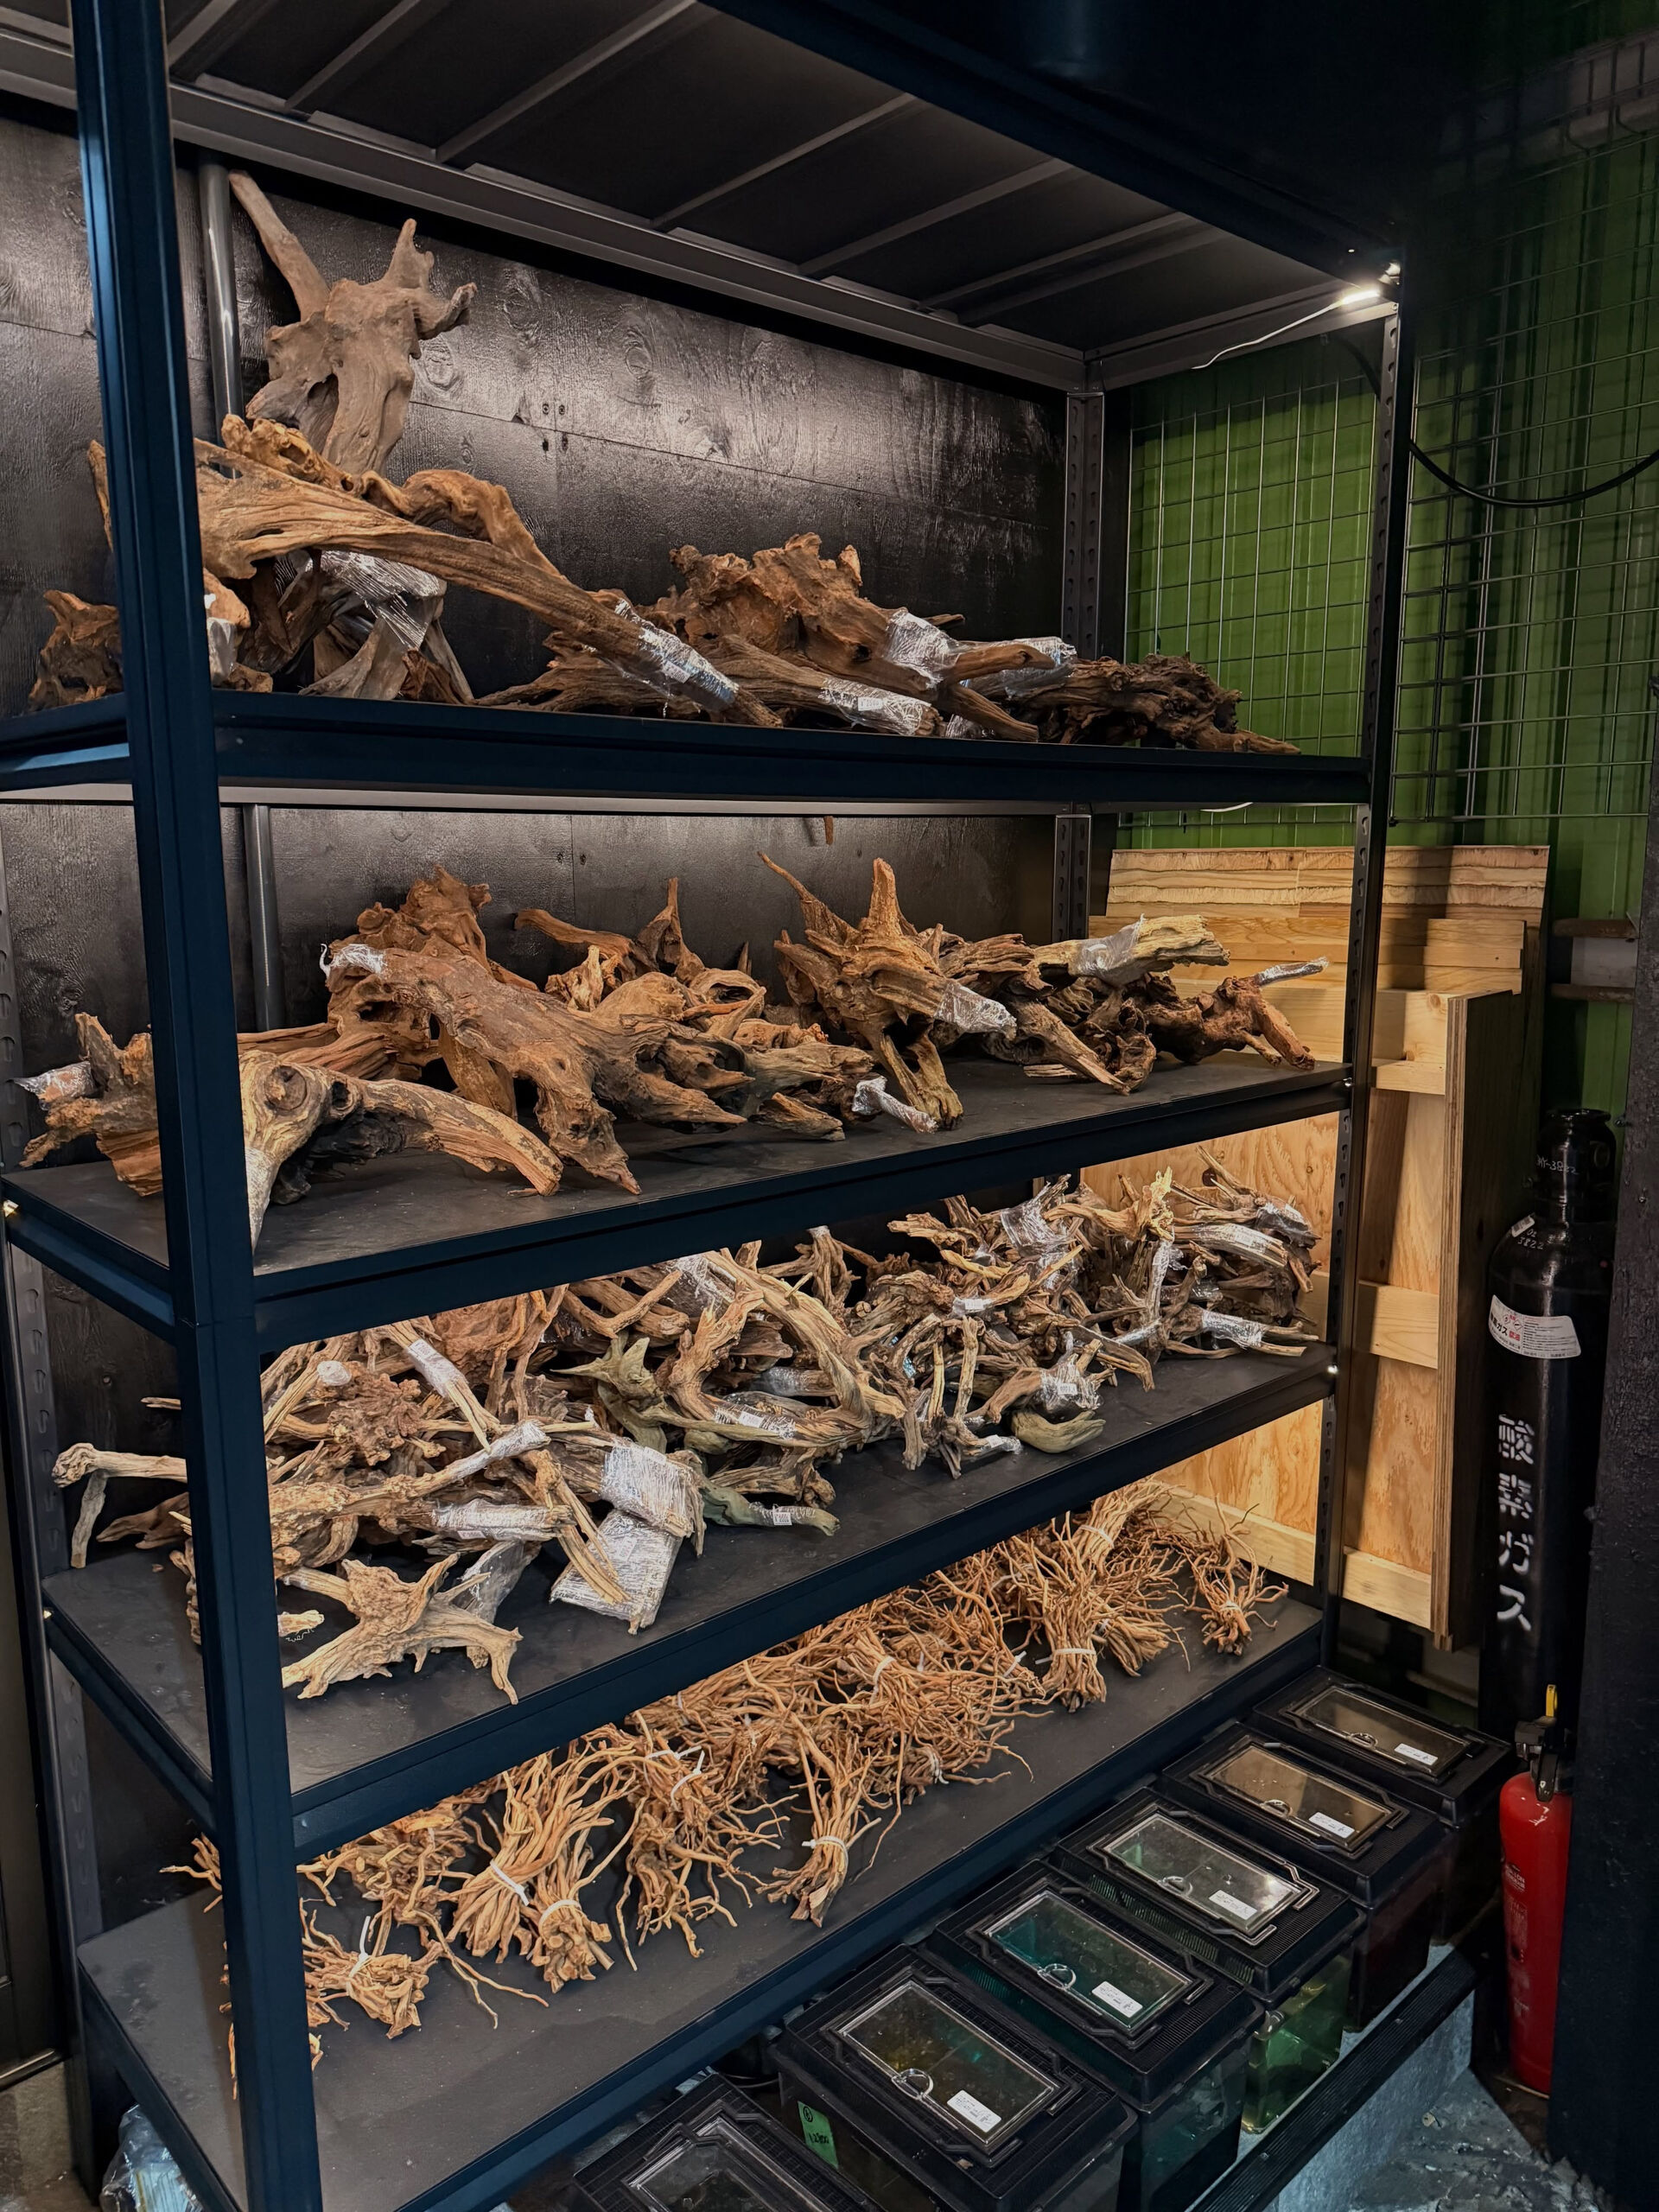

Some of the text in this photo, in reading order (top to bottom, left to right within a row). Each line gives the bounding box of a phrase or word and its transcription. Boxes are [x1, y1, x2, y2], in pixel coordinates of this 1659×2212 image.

[1518, 1236, 1543, 1249] 3822
[1497, 1414, 1535, 1631] 酸素ガス
